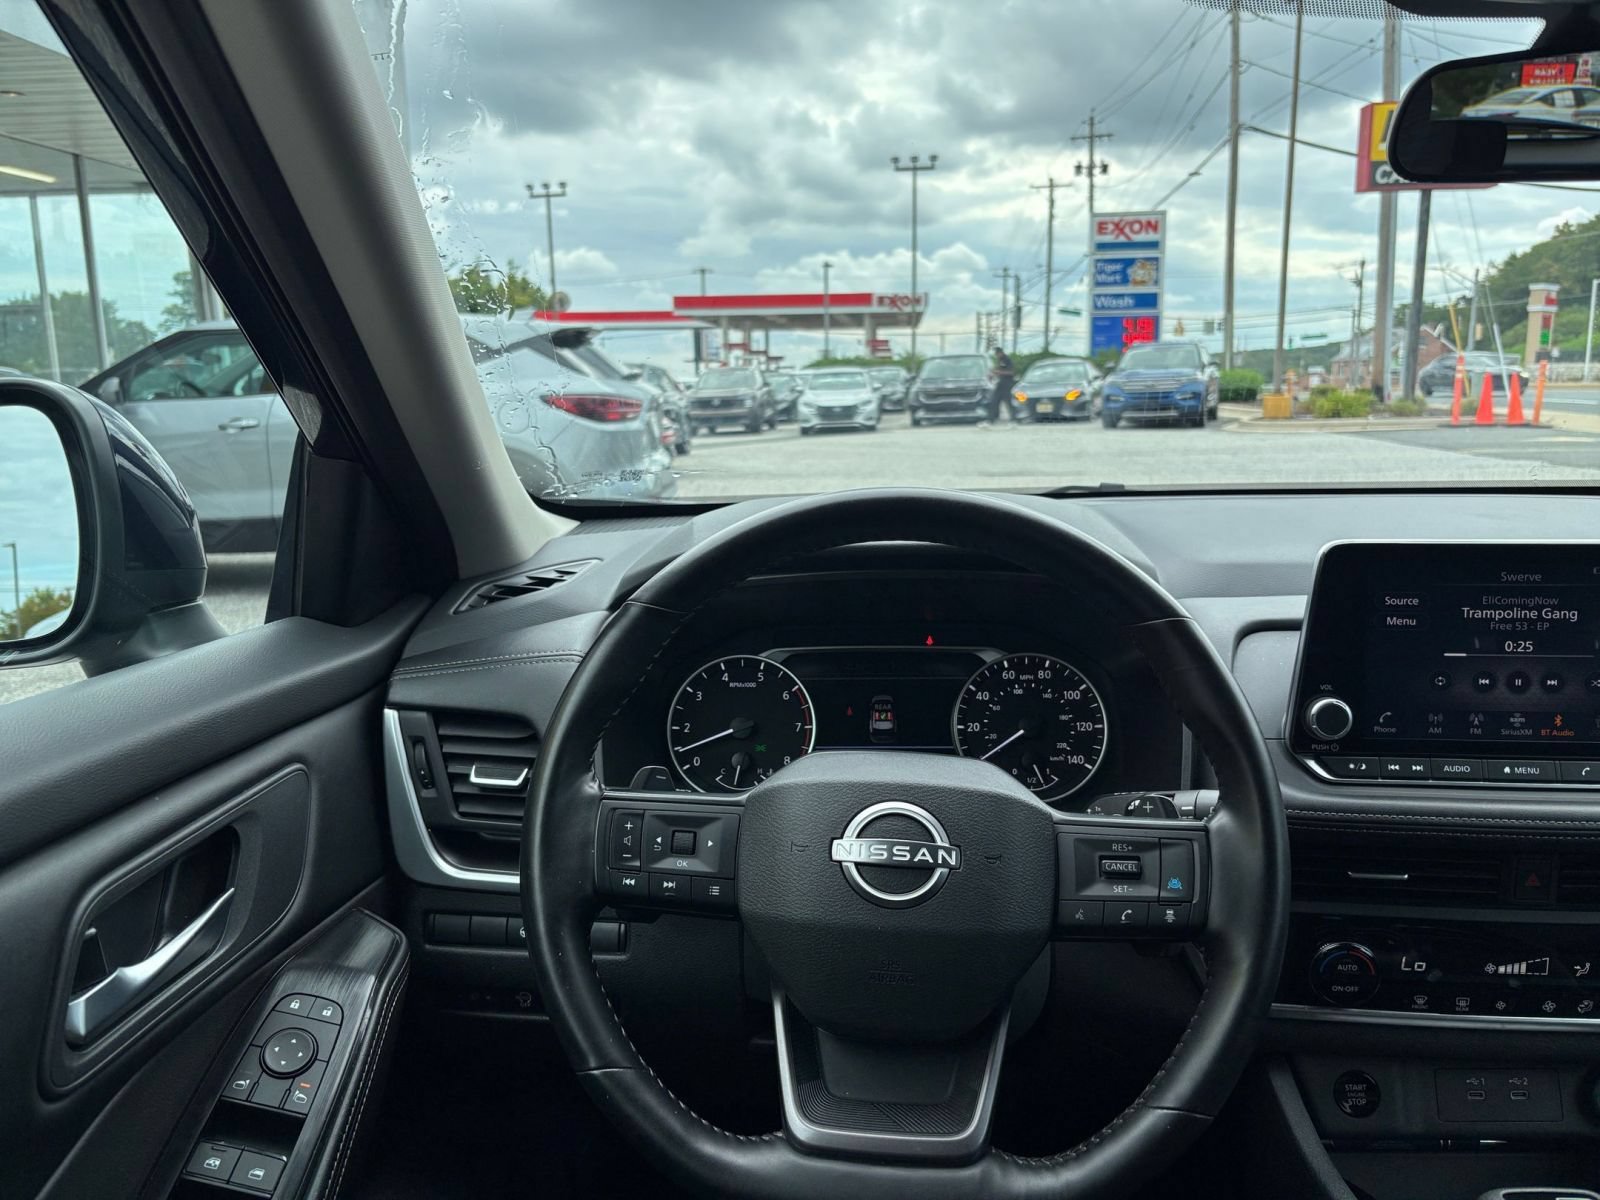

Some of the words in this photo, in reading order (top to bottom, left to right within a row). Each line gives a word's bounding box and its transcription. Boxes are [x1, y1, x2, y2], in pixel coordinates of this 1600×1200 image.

[1096, 218, 1159, 240] EXXON
[877, 294, 922, 312] EXXON
[1094, 296, 1134, 308] Wash
[1500, 572, 1542, 582] Swerve
[1384, 596, 1419, 605] Source
[1482, 596, 1558, 606] EliComingNow
[1462, 608, 1538, 621] Trampoline
[1542, 608, 1578, 622] Gang
[1386, 617, 1416, 626] Menu
[1490, 622, 1512, 630] Free
[1516, 622, 1528, 630] 53
[1537, 622, 1550, 630] EP
[1504, 641, 1534, 652] 0:25
[722, 673, 728, 682] 4
[758, 673, 764, 681] 5
[1002, 670, 1015, 679] 60
[1038, 670, 1051, 679] 80
[696, 692, 702, 701] 3
[783, 692, 789, 700] 6
[976, 692, 989, 700] 40
[1064, 691, 1080, 700] 100
[684, 723, 690, 732] 2
[795, 723, 802, 732] 7
[967, 723, 980, 732] 20
[1076, 722, 1092, 731] 120
[1374, 726, 1396, 734] Phone
[694, 757, 700, 766] 0
[784, 756, 790, 765] 8
[1067, 755, 1084, 764] 140
[1443, 765, 1470, 773] AUDIO
[836, 840, 957, 867] NISSAN
[1105, 863, 1136, 871] CANCEL
[1401, 956, 1426, 972] Lo
